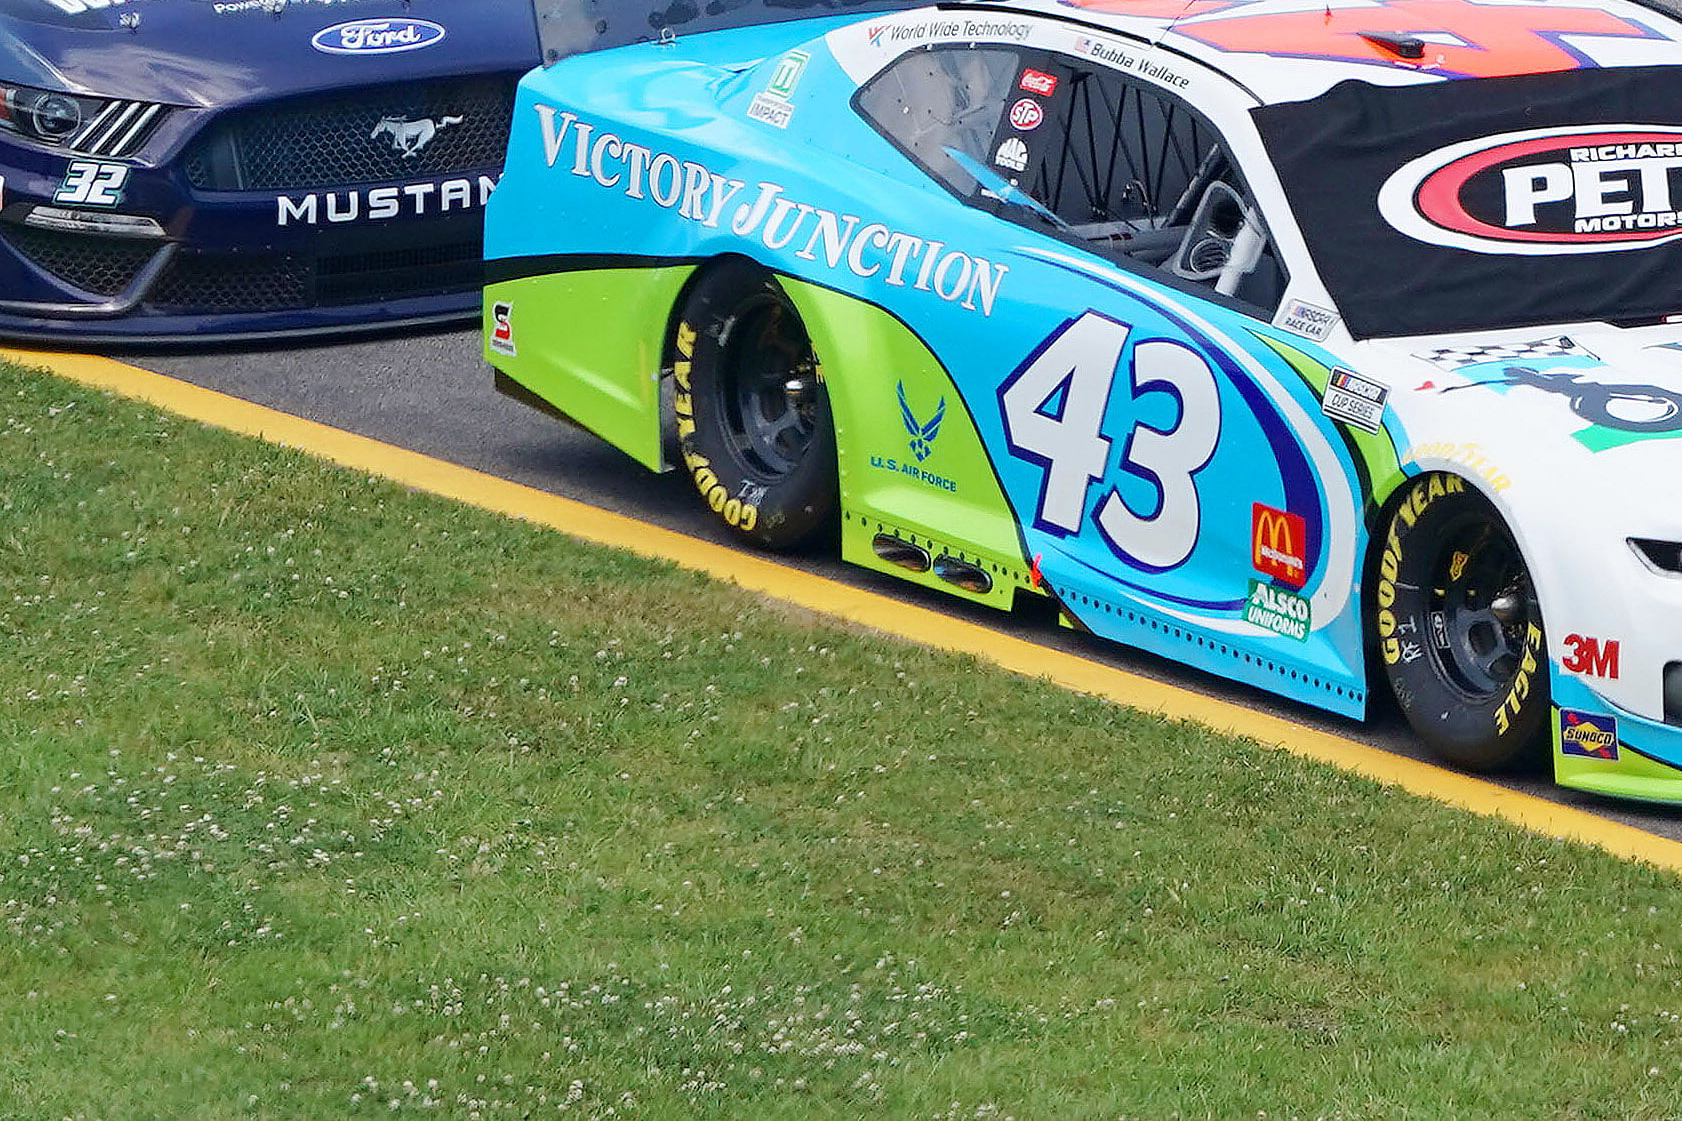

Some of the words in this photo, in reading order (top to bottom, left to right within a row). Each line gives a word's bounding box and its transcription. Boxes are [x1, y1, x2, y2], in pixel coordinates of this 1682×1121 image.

[339, 23, 422, 49] Ford
[891, 23, 926, 42] World
[929, 22, 961, 39] Wide
[962, 19, 1033, 41] Technology
[1090, 42, 1134, 68] Bubba
[1136, 57, 1191, 90] Wallace
[751, 102, 791, 128] IMPACT
[1010, 102, 1042, 125] STP
[56, 162, 129, 205] 32
[276, 173, 505, 225] MUSTAN
[533, 103, 746, 229] VICTORY
[731, 181, 1010, 318] JUNCTION
[1305, 323, 1322, 337] CAR
[674, 321, 759, 531] GOODYEAR
[1331, 393, 1349, 409] CUP
[1349, 399, 1375, 420] SERIES
[997, 309, 1222, 570] 43
[870, 456, 900, 472] U.S.
[901, 463, 920, 479] AIR
[921, 470, 957, 493] FORCE
[1380, 473, 1465, 666] GOODYEAR
[1251, 582, 1309, 621] ALSCO
[1247, 605, 1306, 640] UNIFORMS
[1560, 633, 1620, 681] 3M
[1494, 620, 1542, 737] EAGLE
[1565, 727, 1614, 750] SUNOCO
